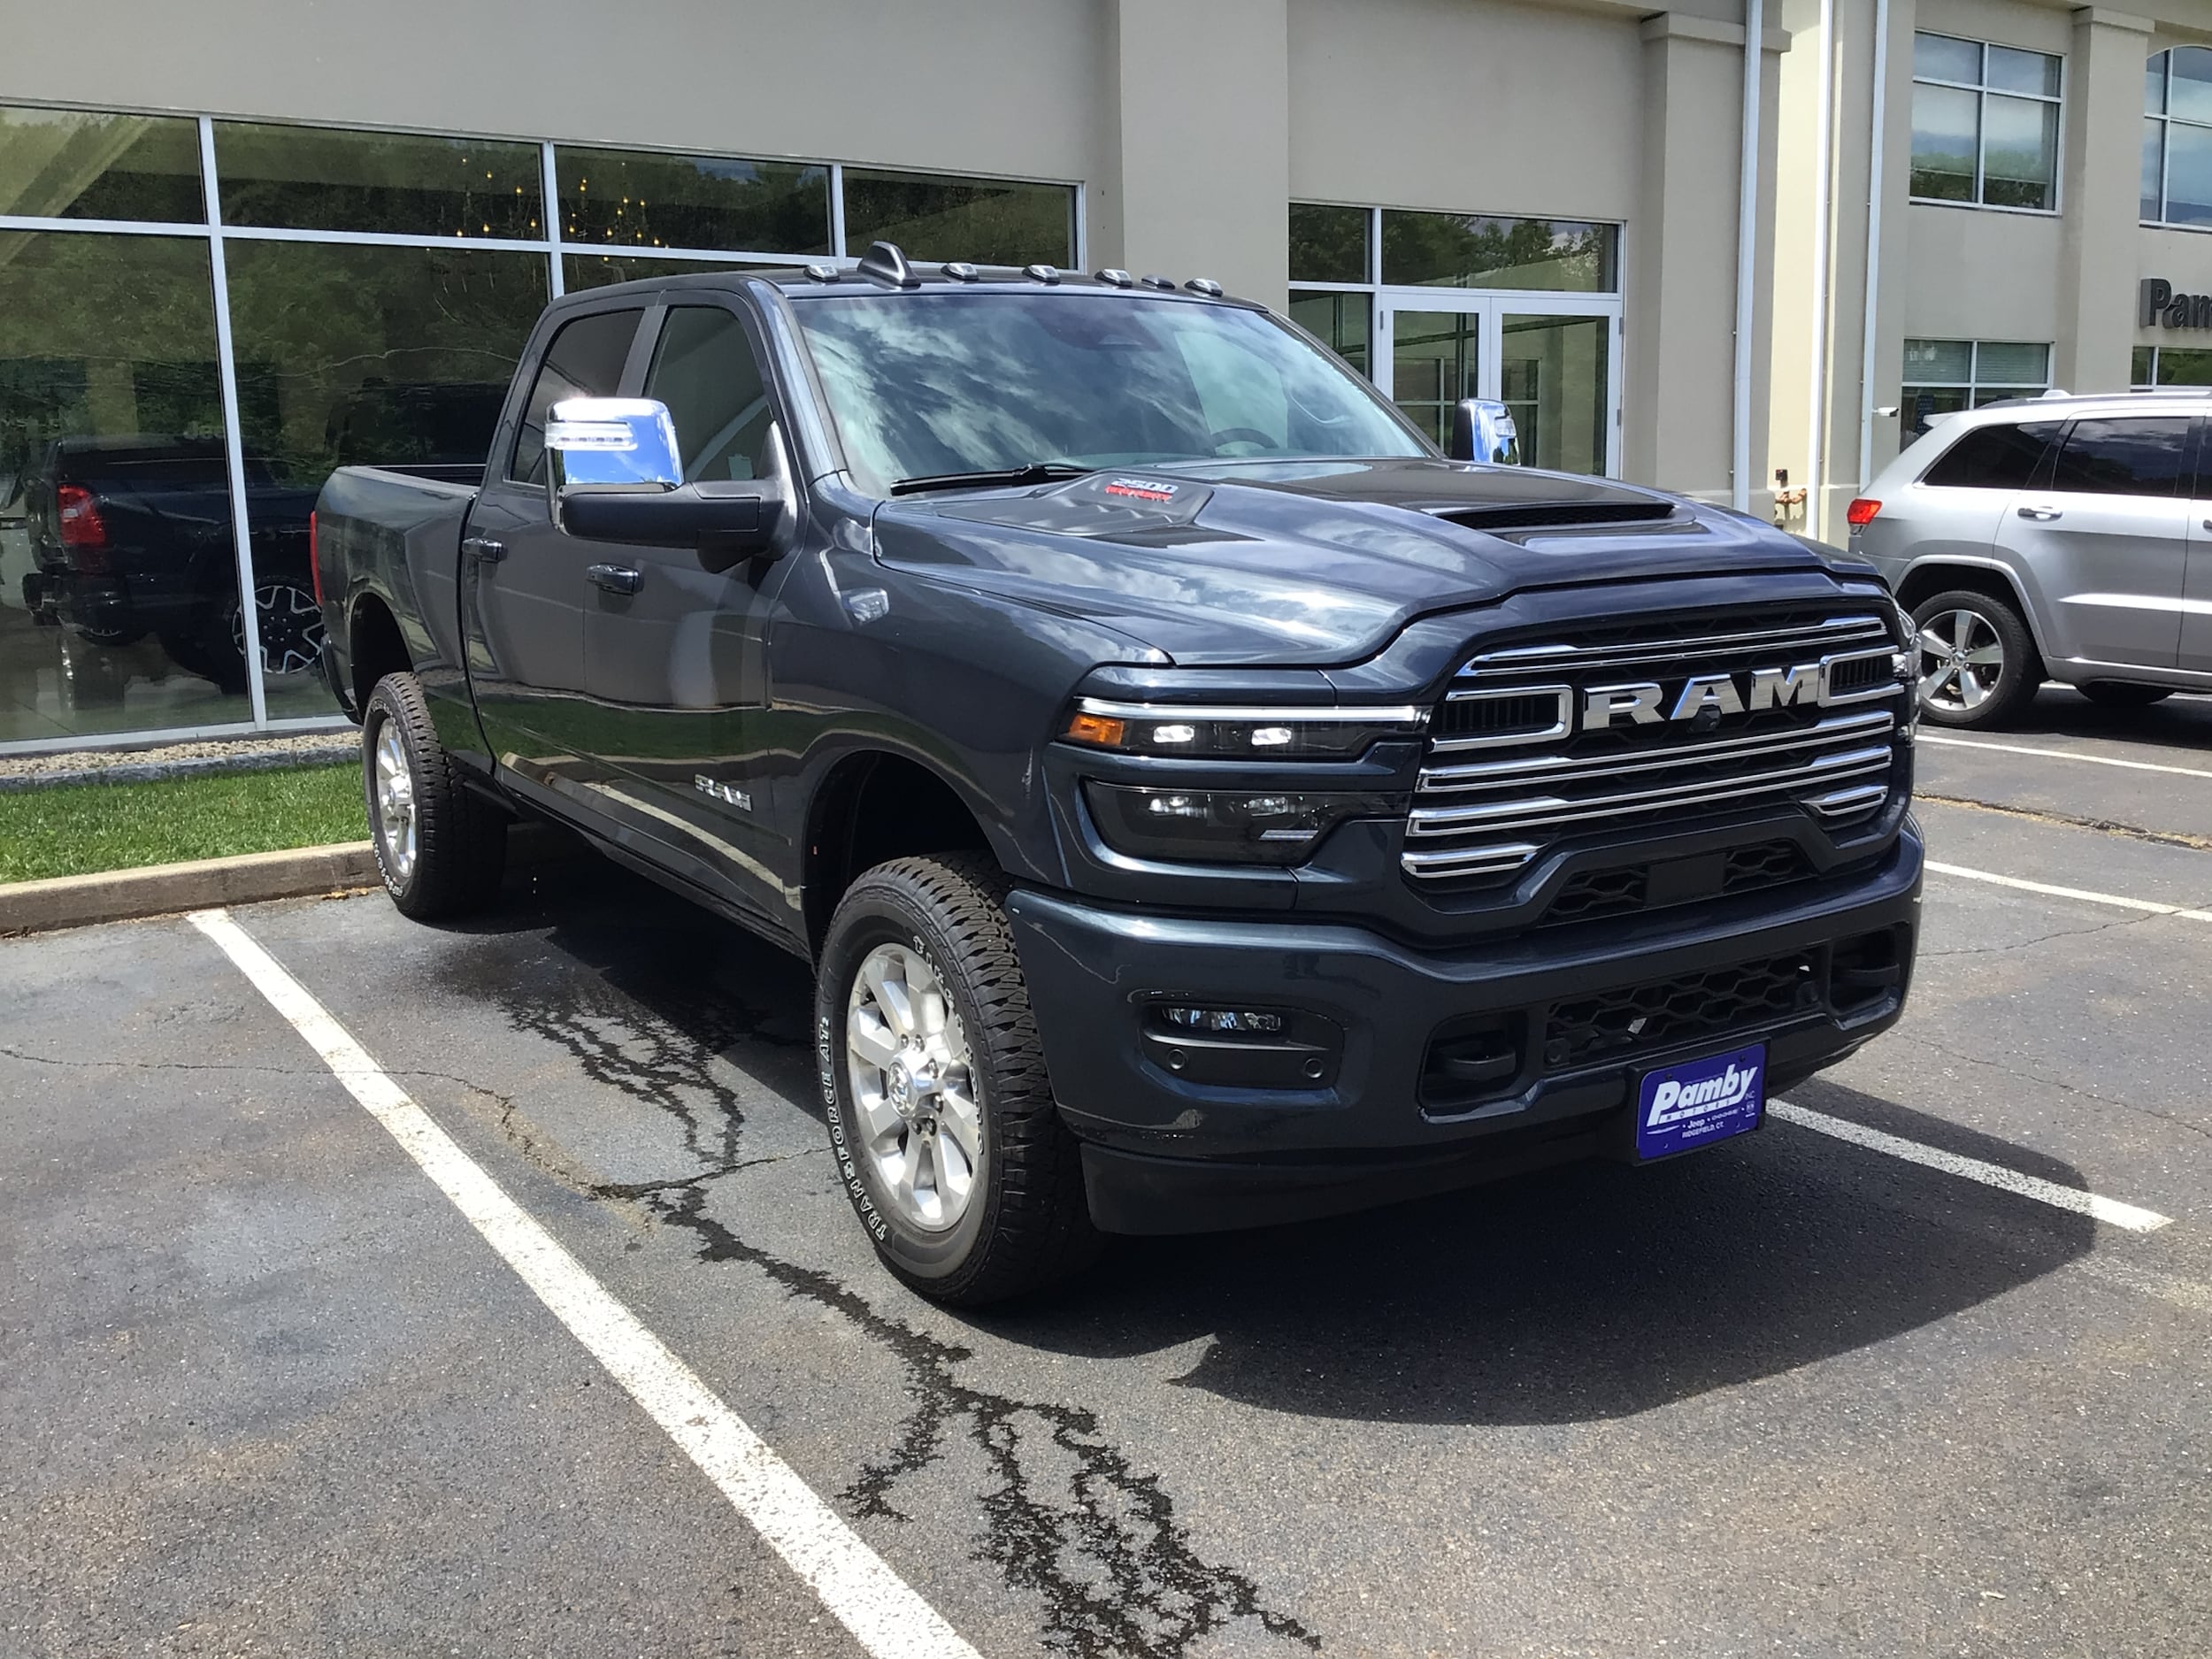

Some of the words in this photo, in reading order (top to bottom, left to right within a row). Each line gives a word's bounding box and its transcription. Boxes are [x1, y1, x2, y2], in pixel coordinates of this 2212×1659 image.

[1111, 478, 1179, 494] 2500
[1582, 663, 1820, 730] RAM
[1647, 1064, 1758, 1126] Pamby
[821, 1071, 887, 1241] TRANSFORCE
